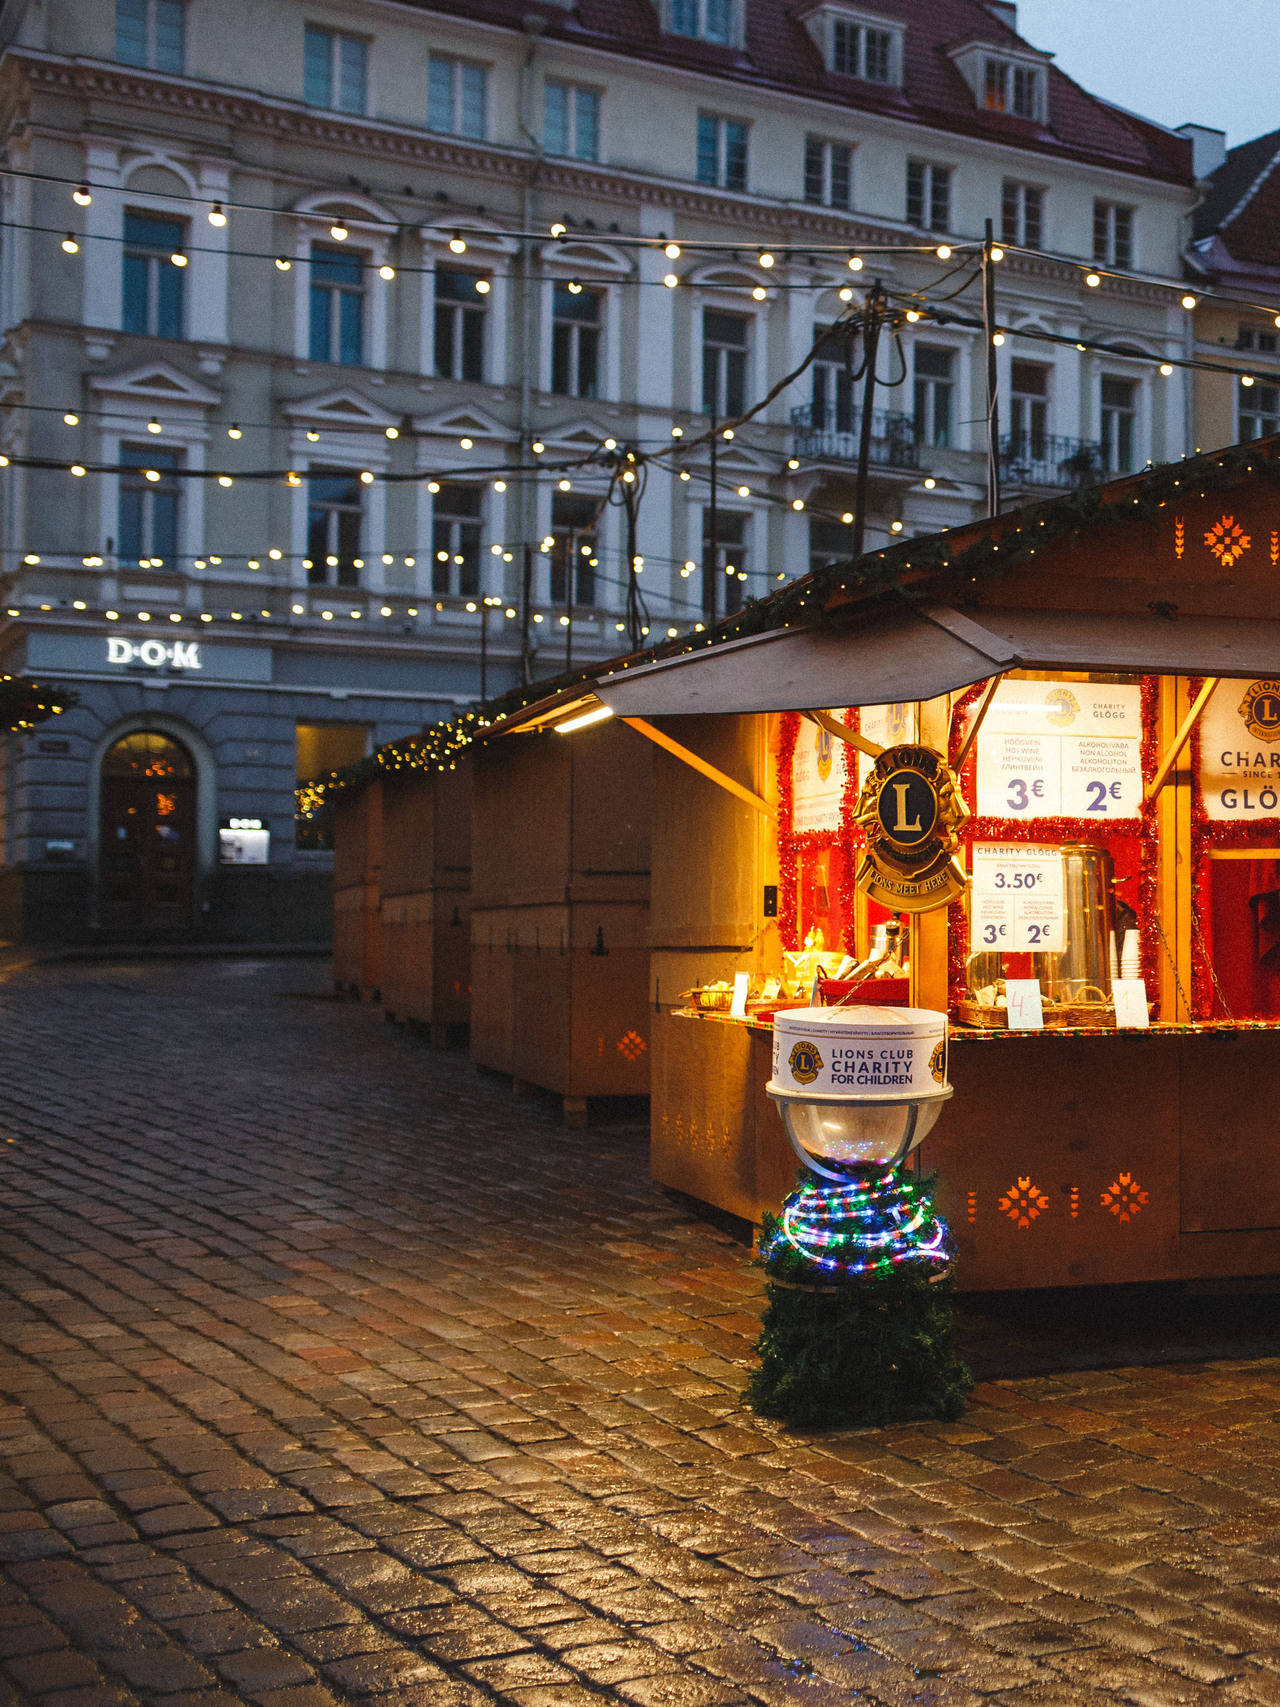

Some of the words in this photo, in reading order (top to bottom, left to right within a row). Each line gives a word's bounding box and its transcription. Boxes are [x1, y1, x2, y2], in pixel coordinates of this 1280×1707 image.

[1093, 710, 1126, 719] GLÖGG
[1262, 699, 1278, 721] L
[1078, 741, 1129, 749] ALKOHOLIVABA
[1243, 770, 1273, 779] SINCE
[892, 783, 922, 832] L
[977, 847, 1021, 855] CHARITY
[869, 869, 893, 890] LIONS
[896, 883, 921, 895] MEET
[925, 872, 950, 892] HERE
[795, 1042, 816, 1053] LIONS
[831, 1049, 874, 1060] LIONS
[880, 1049, 914, 1060] CLUB
[800, 1054, 810, 1070] L
[831, 1060, 913, 1074] CHARITY
[831, 1074, 855, 1085] FOR
[857, 1074, 913, 1085] CHILDREN
